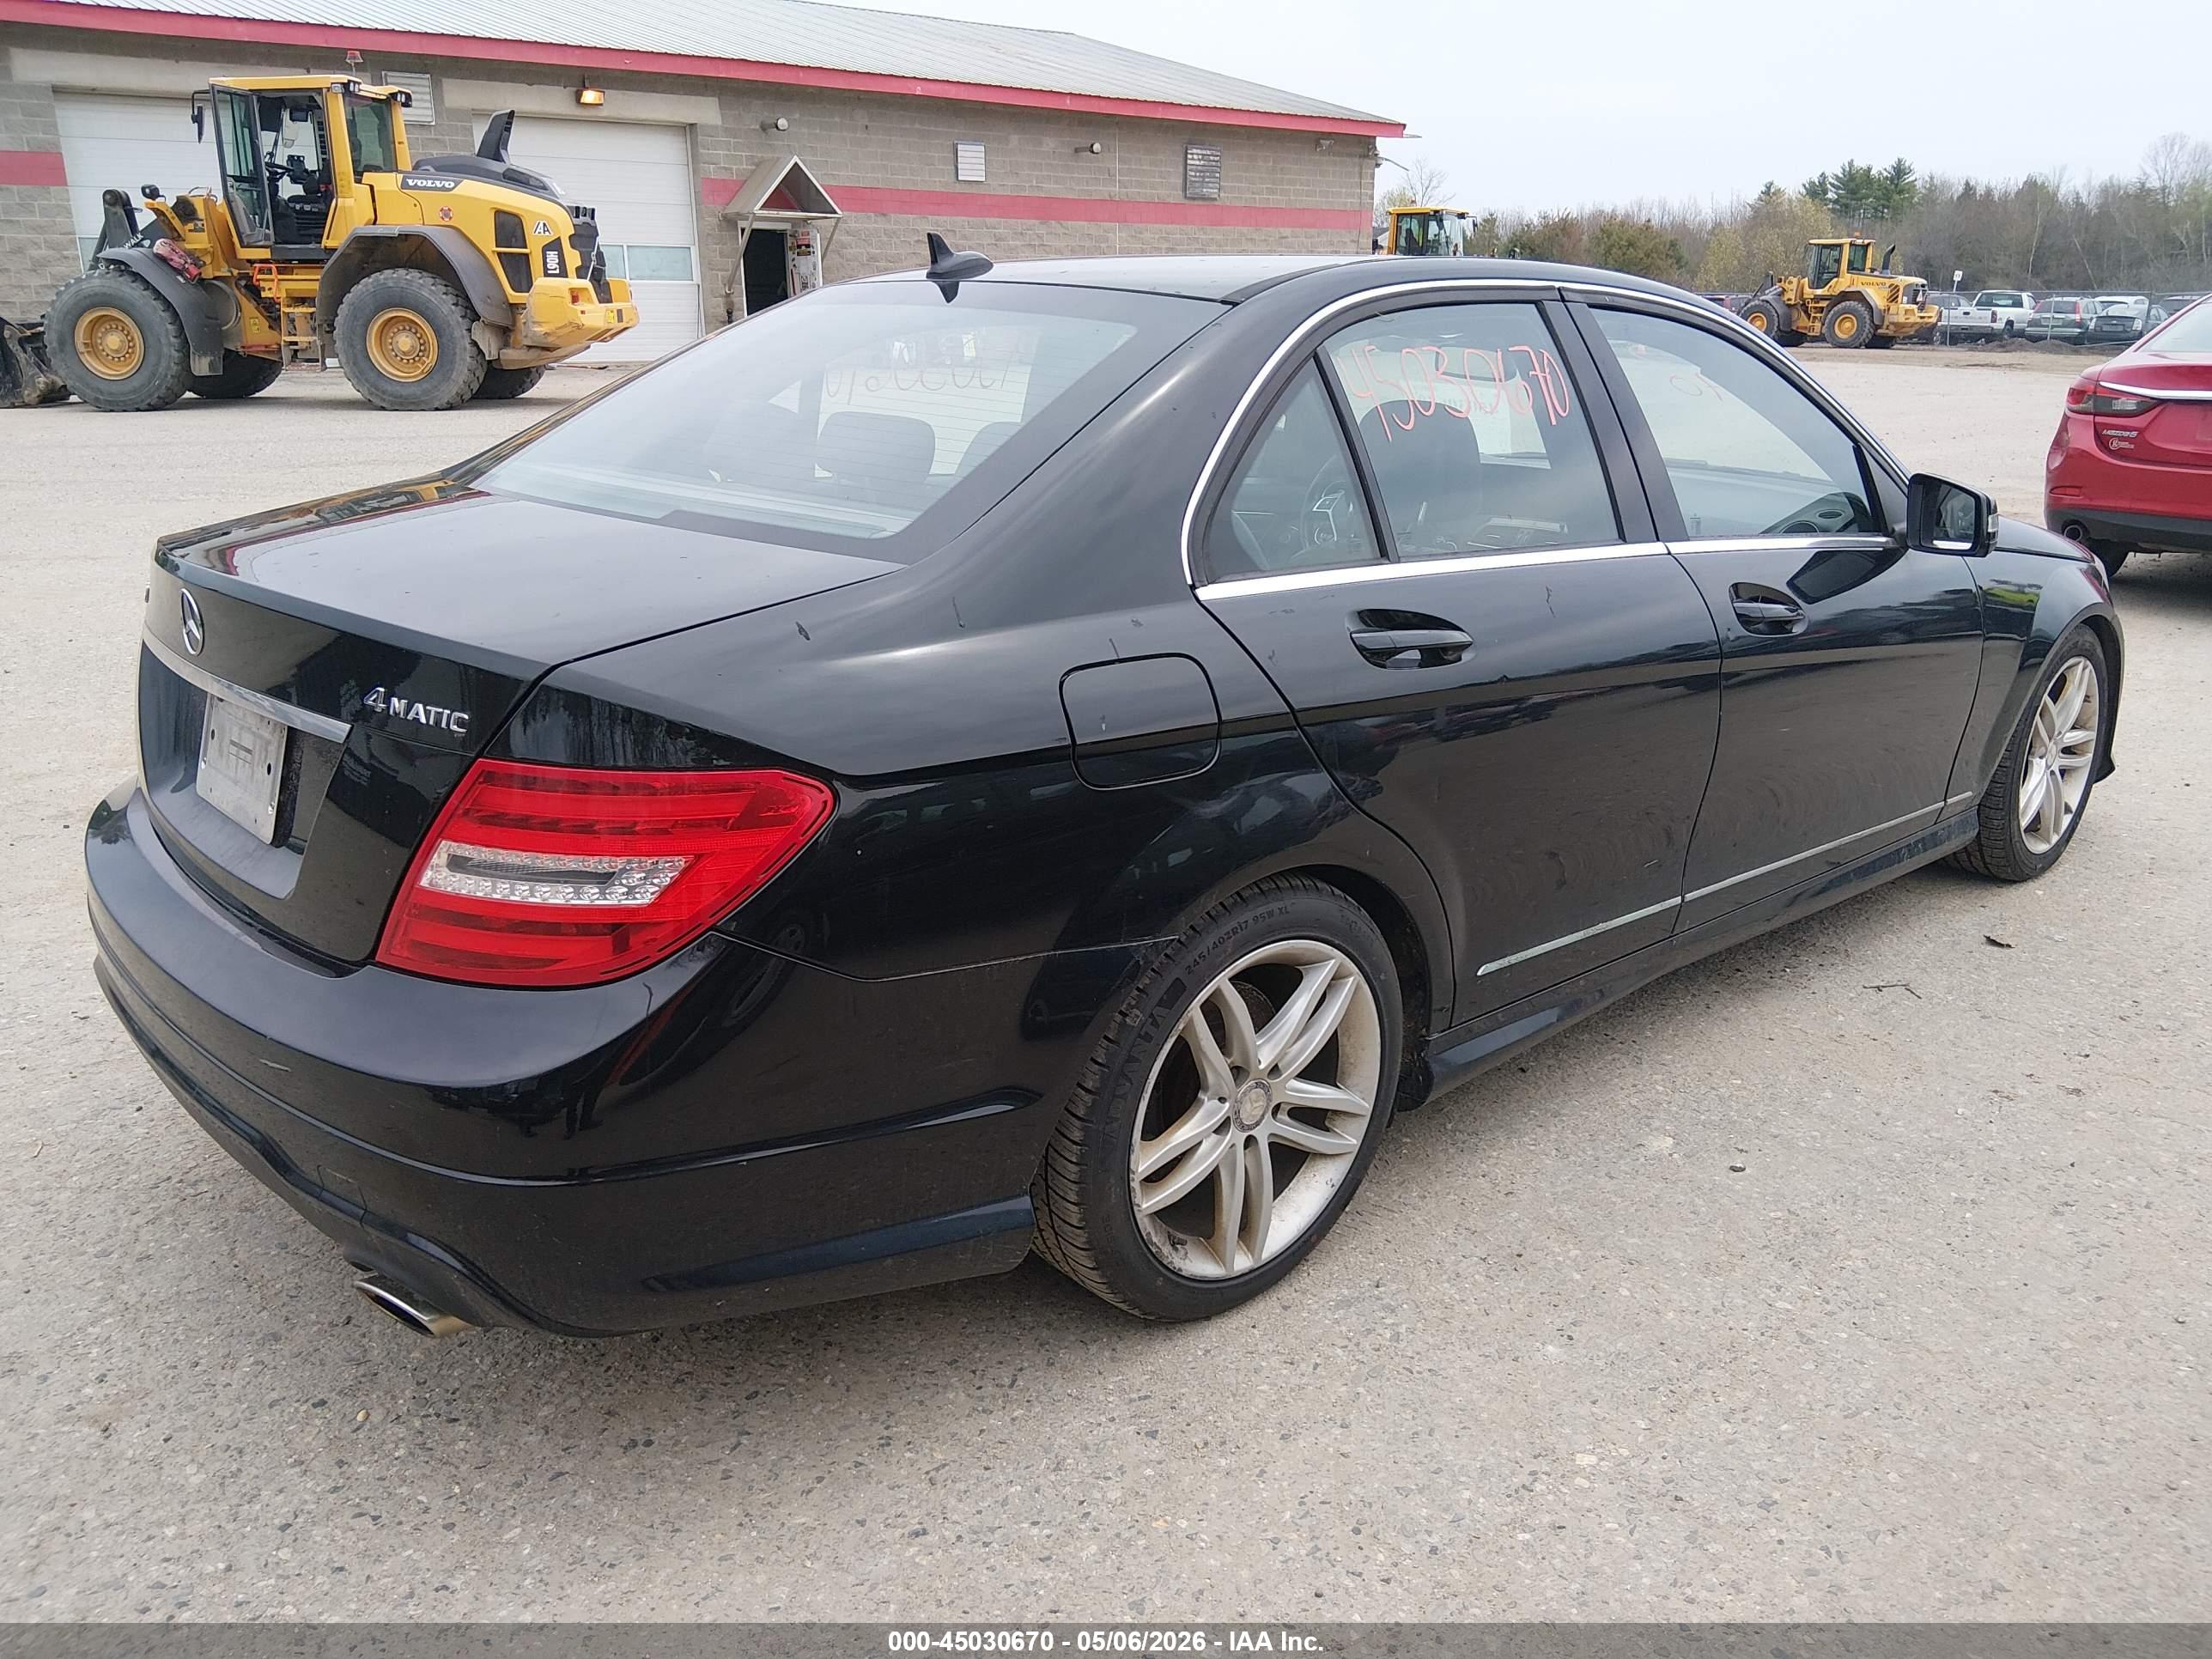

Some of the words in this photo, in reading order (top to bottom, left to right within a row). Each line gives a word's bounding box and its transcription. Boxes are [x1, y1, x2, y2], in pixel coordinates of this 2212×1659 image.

[405, 178, 455, 189] VOLVO
[123, 232, 144, 249] WALK
[546, 250, 560, 275] L90H
[1336, 345, 1570, 442] 45030670
[363, 687, 469, 733] 4MATIC
[1184, 915, 1249, 976] 245/40ZR17
[1252, 906, 1275, 925] 95W
